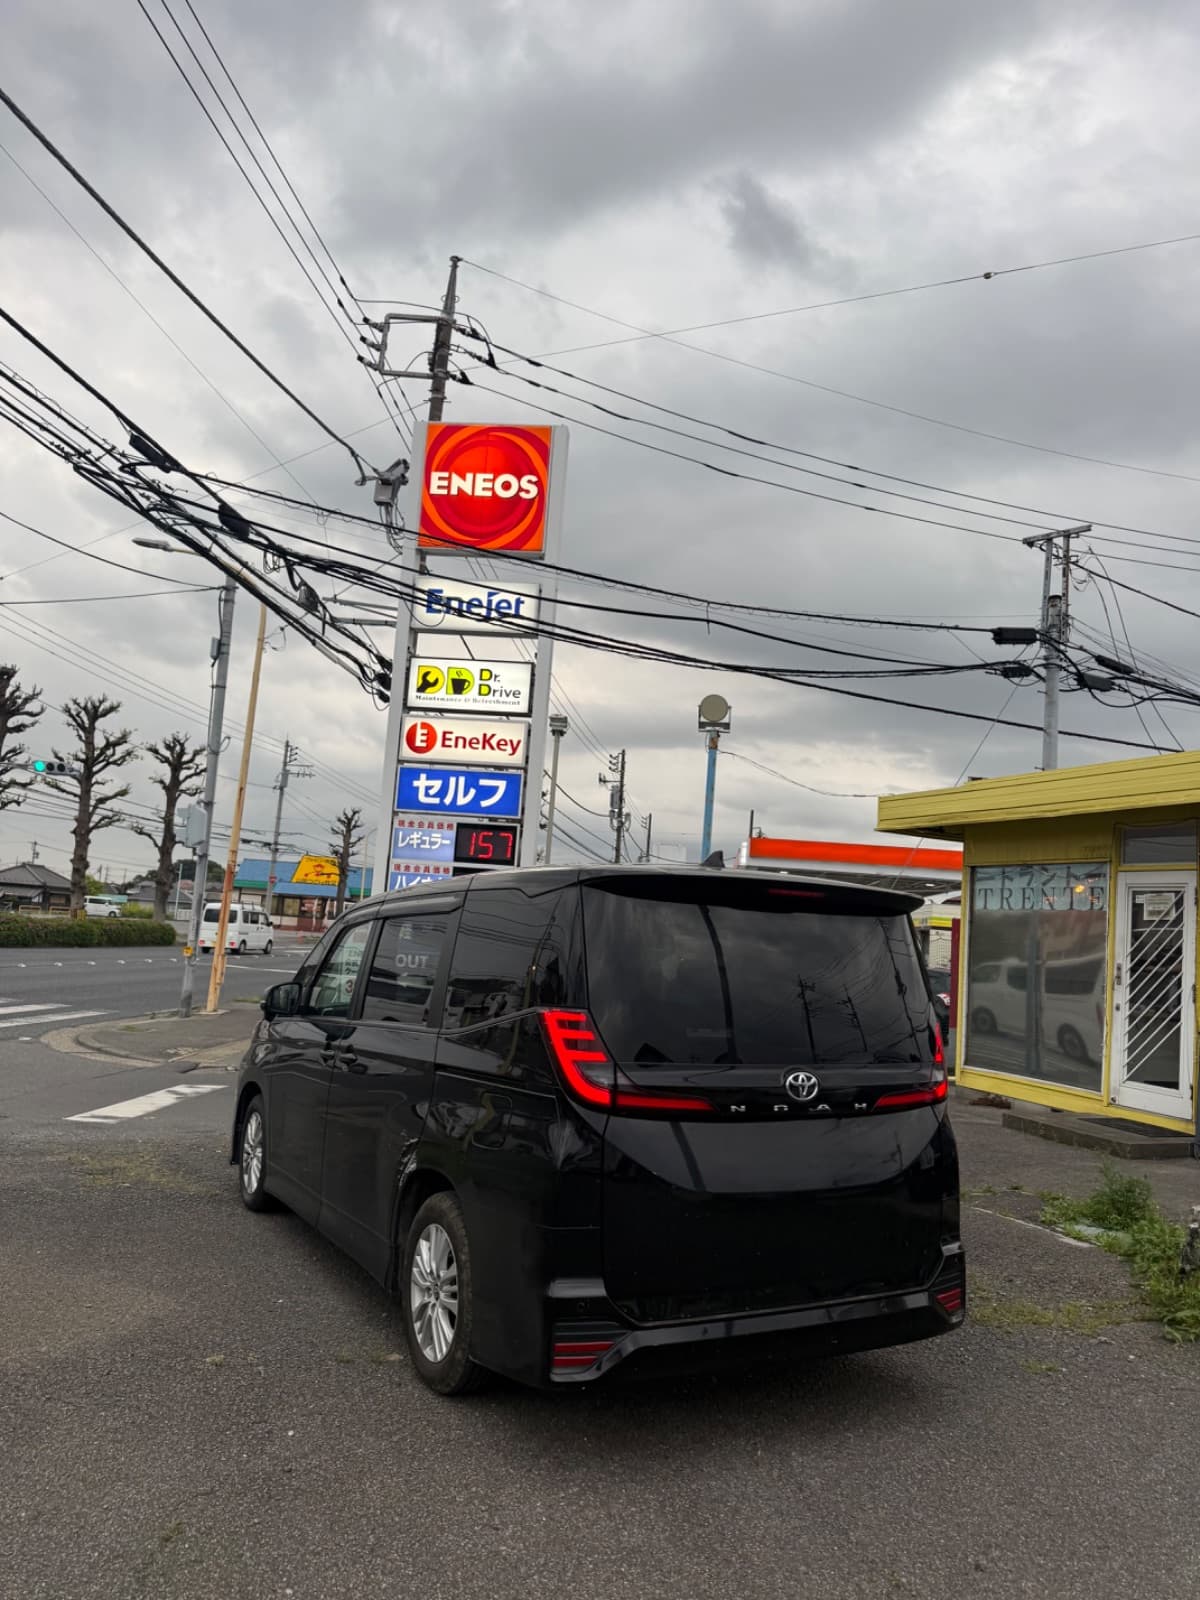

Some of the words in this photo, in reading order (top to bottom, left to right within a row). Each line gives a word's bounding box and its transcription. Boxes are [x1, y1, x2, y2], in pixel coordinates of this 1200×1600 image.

[430, 471, 539, 499] ENEOS
[426, 588, 525, 619] Enejet
[479, 668, 501, 682] Dr.
[478, 683, 521, 698] Drive
[441, 731, 522, 756] EneKey
[412, 773, 507, 808] セルフ
[398, 831, 451, 850] レギュラー
[468, 831, 513, 859] 157
[978, 886, 1106, 911] TRENTE
[395, 954, 429, 969] OUT
